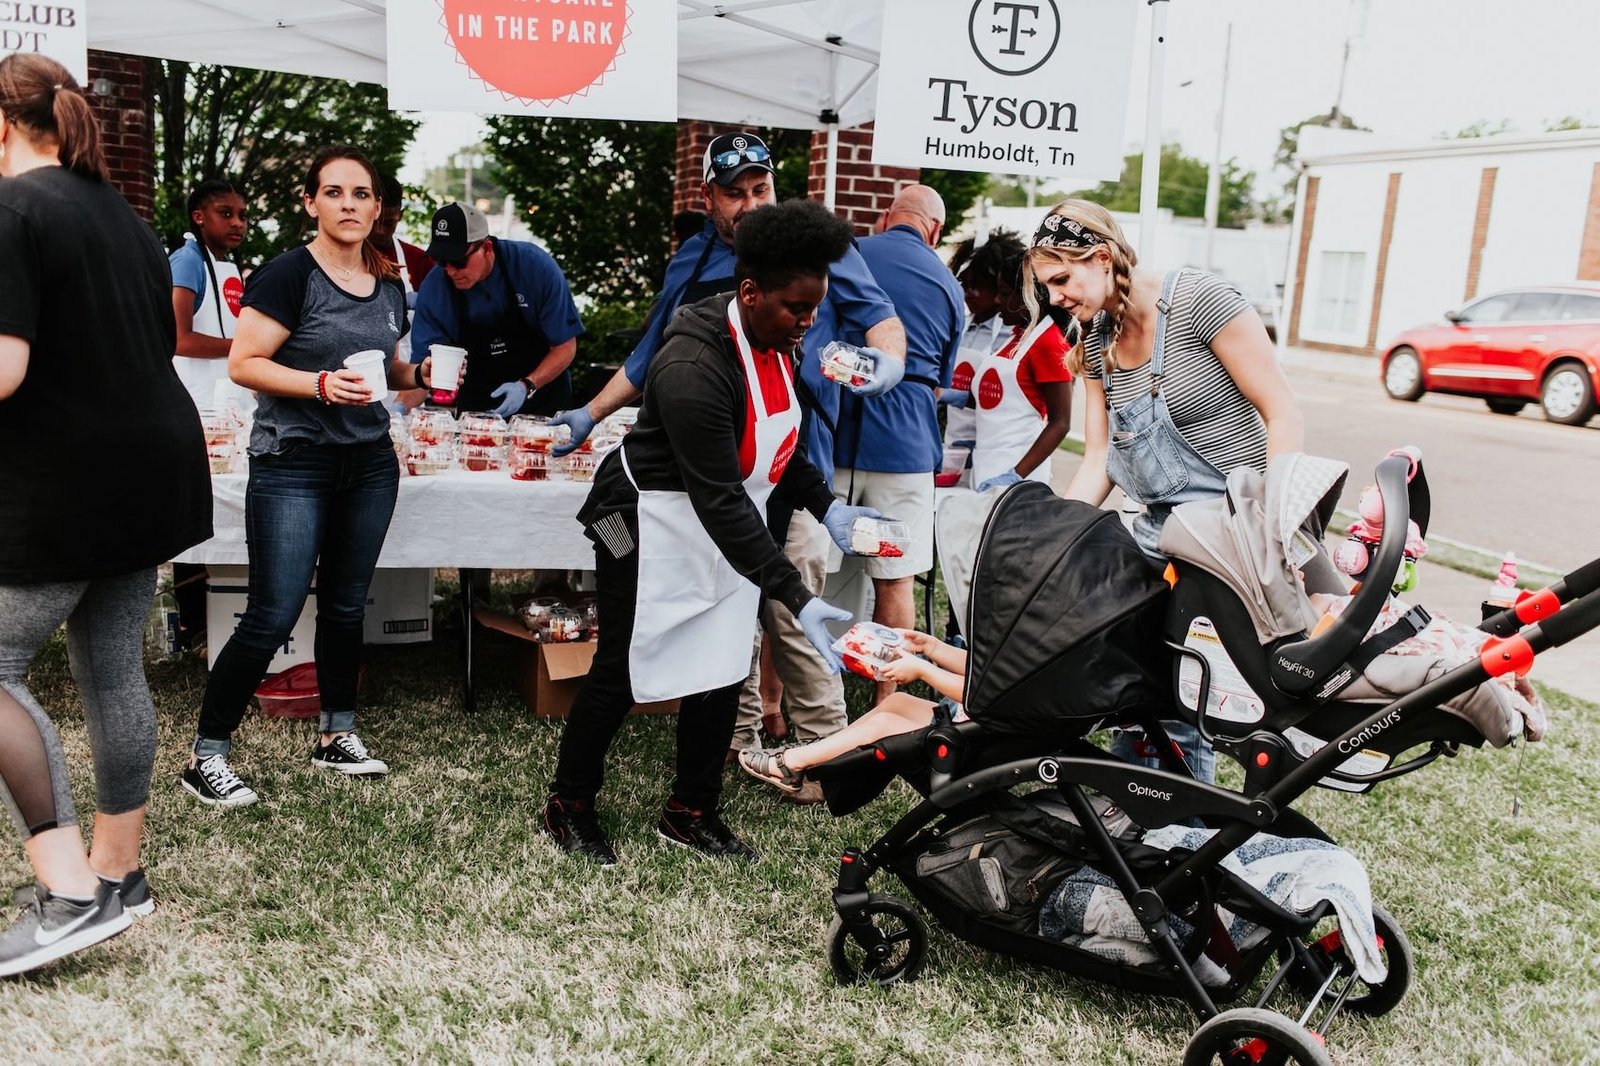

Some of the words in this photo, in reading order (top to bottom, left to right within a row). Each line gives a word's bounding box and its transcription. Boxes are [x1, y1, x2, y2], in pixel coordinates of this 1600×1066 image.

[458, 13, 482, 39] IN
[495, 15, 539, 41] THE
[552, 18, 613, 45] PARK
[928, 77, 1078, 133] Tyson
[925, 136, 1039, 166] Humboldt,
[1048, 146, 1075, 166] Tn
[1338, 711, 1401, 754] Contours
[1127, 782, 1170, 801] Options
